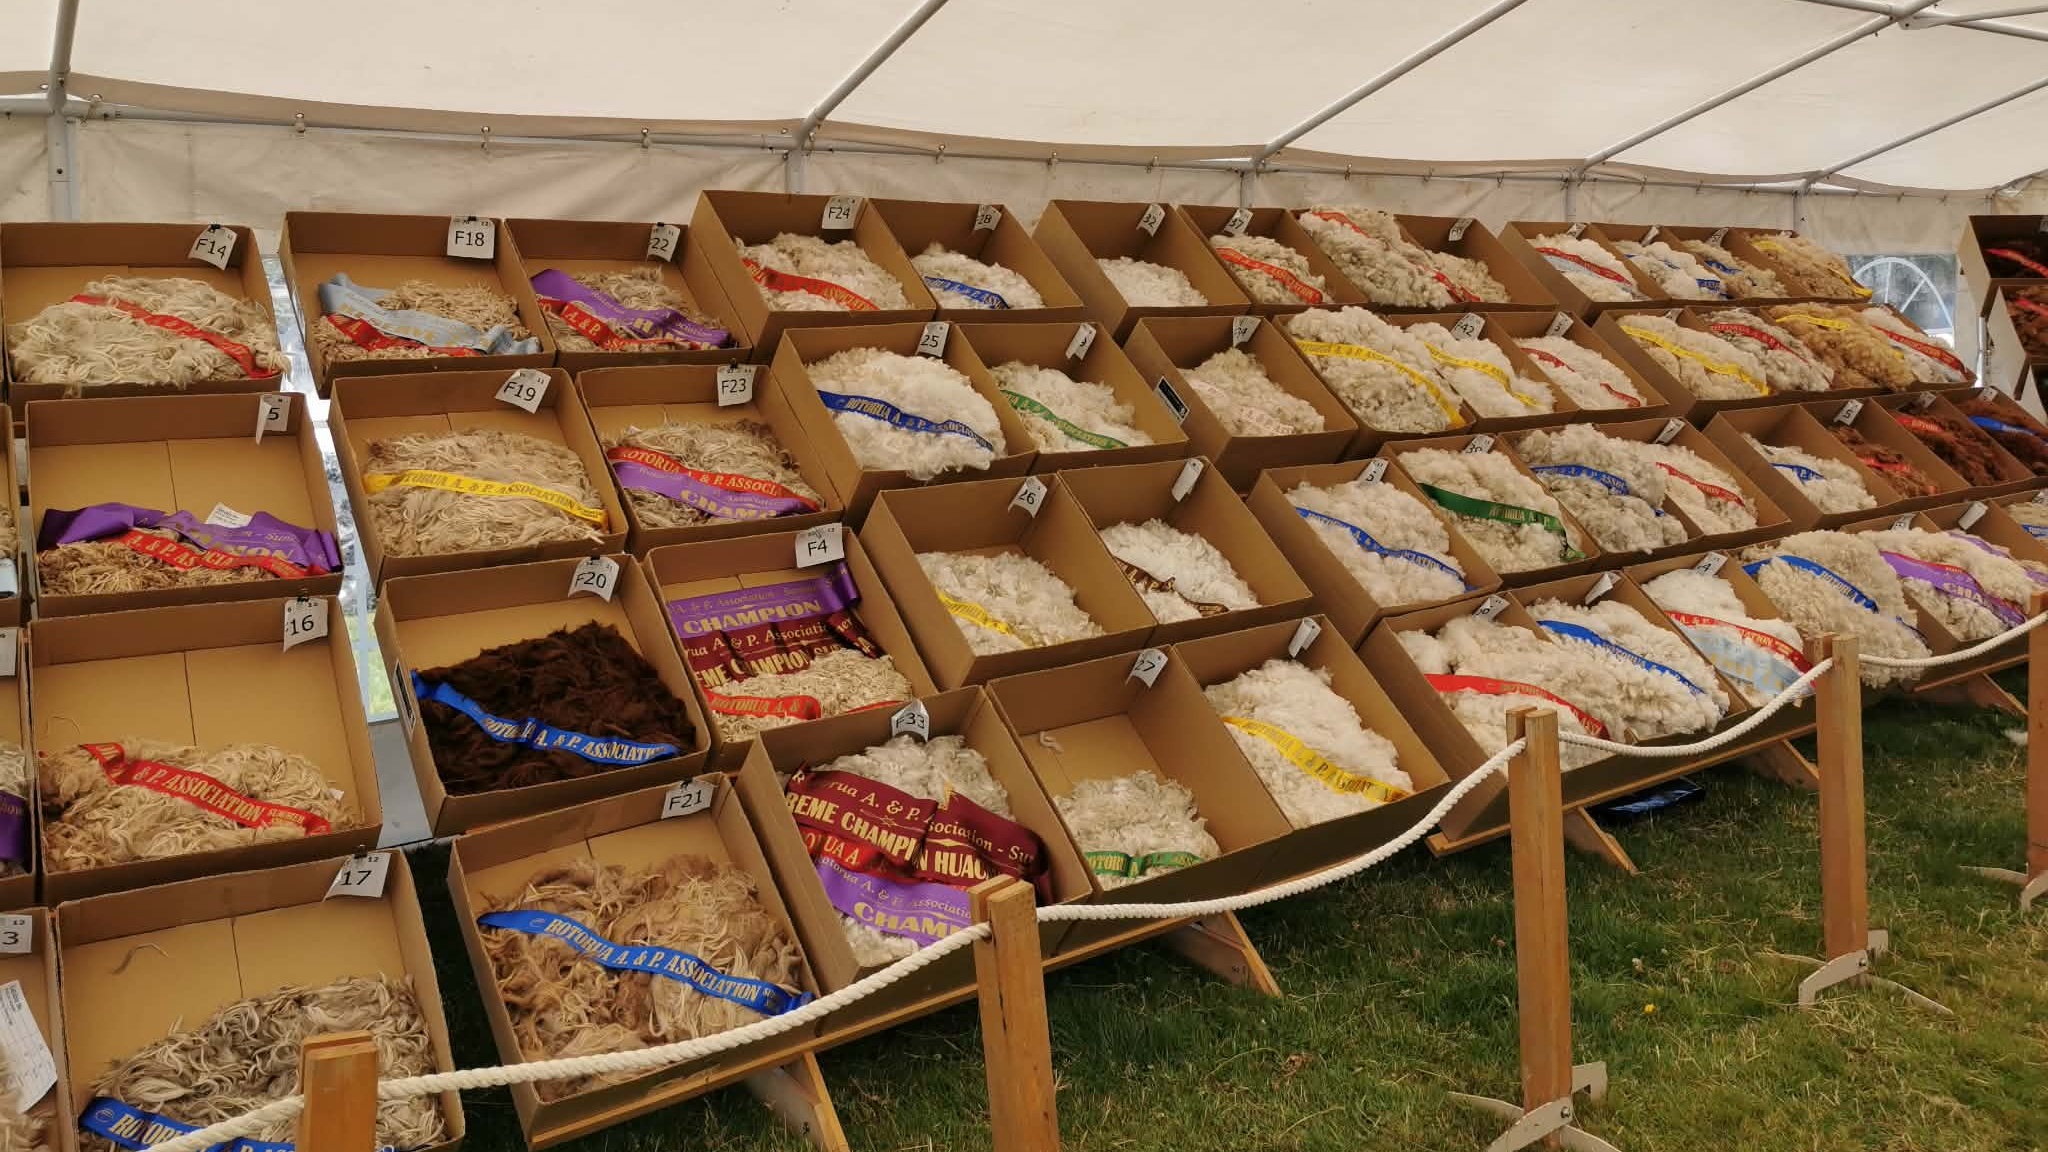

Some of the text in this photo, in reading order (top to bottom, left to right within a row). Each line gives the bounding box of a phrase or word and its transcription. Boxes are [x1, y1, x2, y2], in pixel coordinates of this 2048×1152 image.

[828, 206, 850, 220] F24
[454, 230, 485, 247] F18
[649, 237, 669, 251] 22
[195, 238, 227, 260] F14
[920, 334, 940, 348] 25
[503, 381, 537, 402] F19
[721, 378, 747, 395] F23
[699, 474, 710, 484] &
[1019, 489, 1036, 505] 26
[807, 540, 828, 557] F4
[575, 571, 607, 590] F20
[286, 614, 314, 636] 16
[683, 600, 822, 634] CHAMPION
[730, 637, 743, 649] &
[746, 634, 760, 647] P.
[765, 620, 828, 643] Associati
[894, 712, 927, 730] F33
[534, 729, 548, 747] A.
[566, 735, 583, 749] P.
[147, 768, 166, 785] P.
[164, 771, 266, 824] ASSOCIATION
[669, 789, 702, 811] F21
[859, 792, 880, 808] A.
[886, 800, 904, 815] &
[905, 807, 921, 821] P.
[840, 811, 929, 872] CHAMPIN
[878, 889, 890, 901] &
[2, 931, 19, 946] 3
[543, 918, 615, 962] ROTORUA
[614, 950, 630, 966] A.
[633, 949, 648, 966] &
[647, 951, 666, 969] P.
[664, 955, 763, 1003] ASSOCIATION
